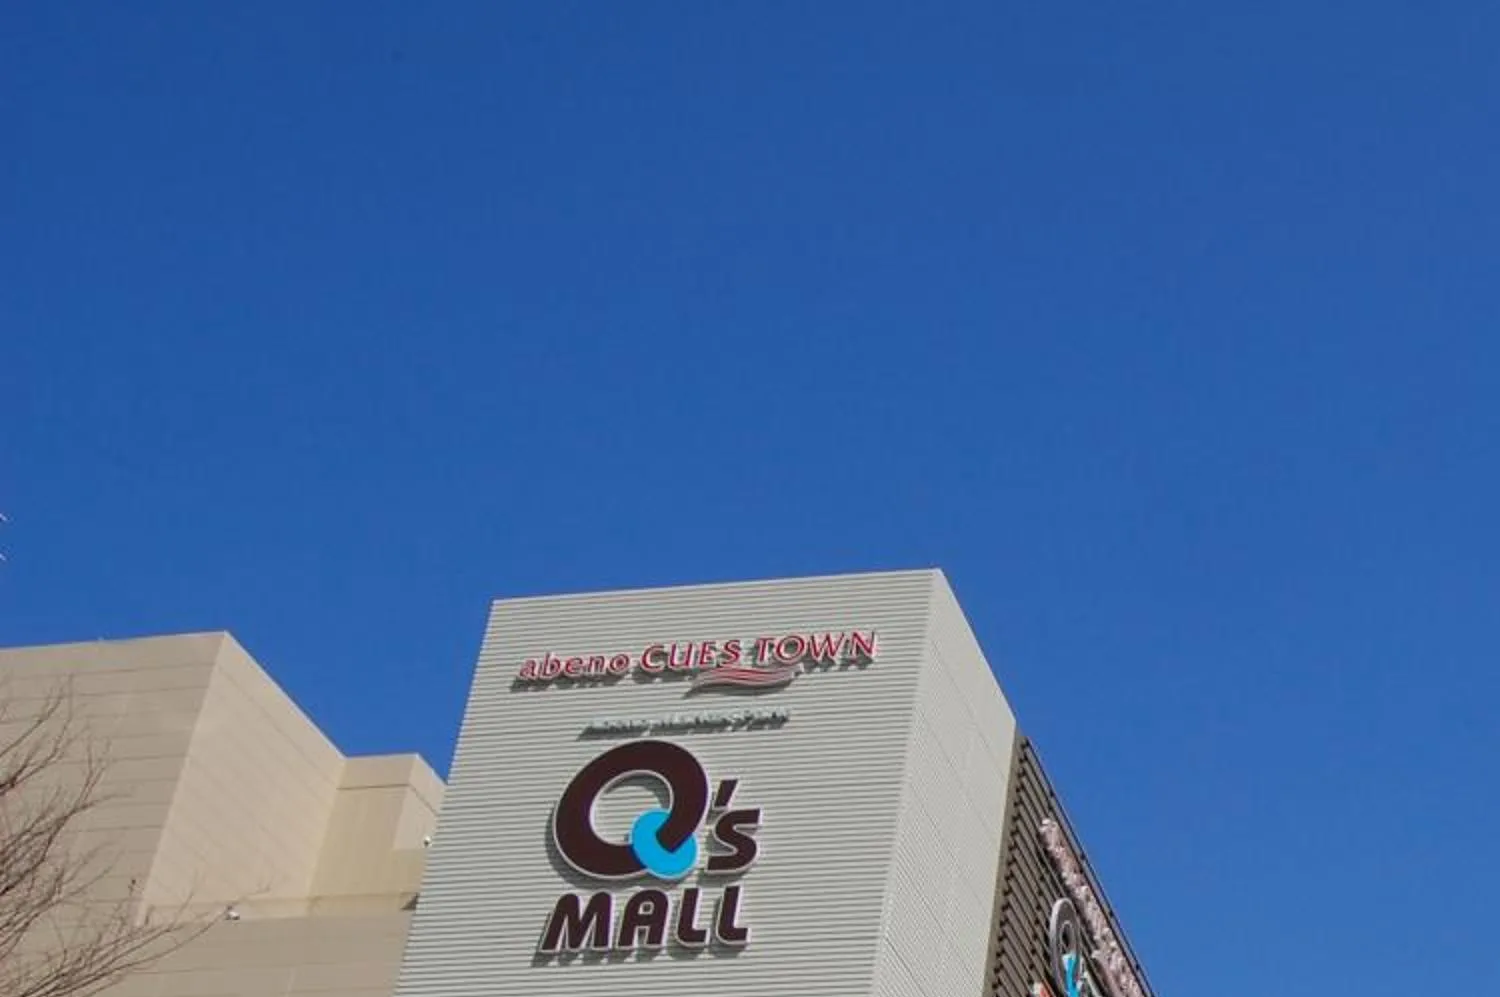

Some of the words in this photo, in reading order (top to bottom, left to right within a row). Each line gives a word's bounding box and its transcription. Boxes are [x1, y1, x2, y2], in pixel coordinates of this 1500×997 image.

[519, 652, 630, 679] abeno
[640, 639, 741, 672] CUES
[755, 630, 876, 663] TOWN
[553, 739, 763, 880] Q's
[540, 884, 749, 953] MALL
